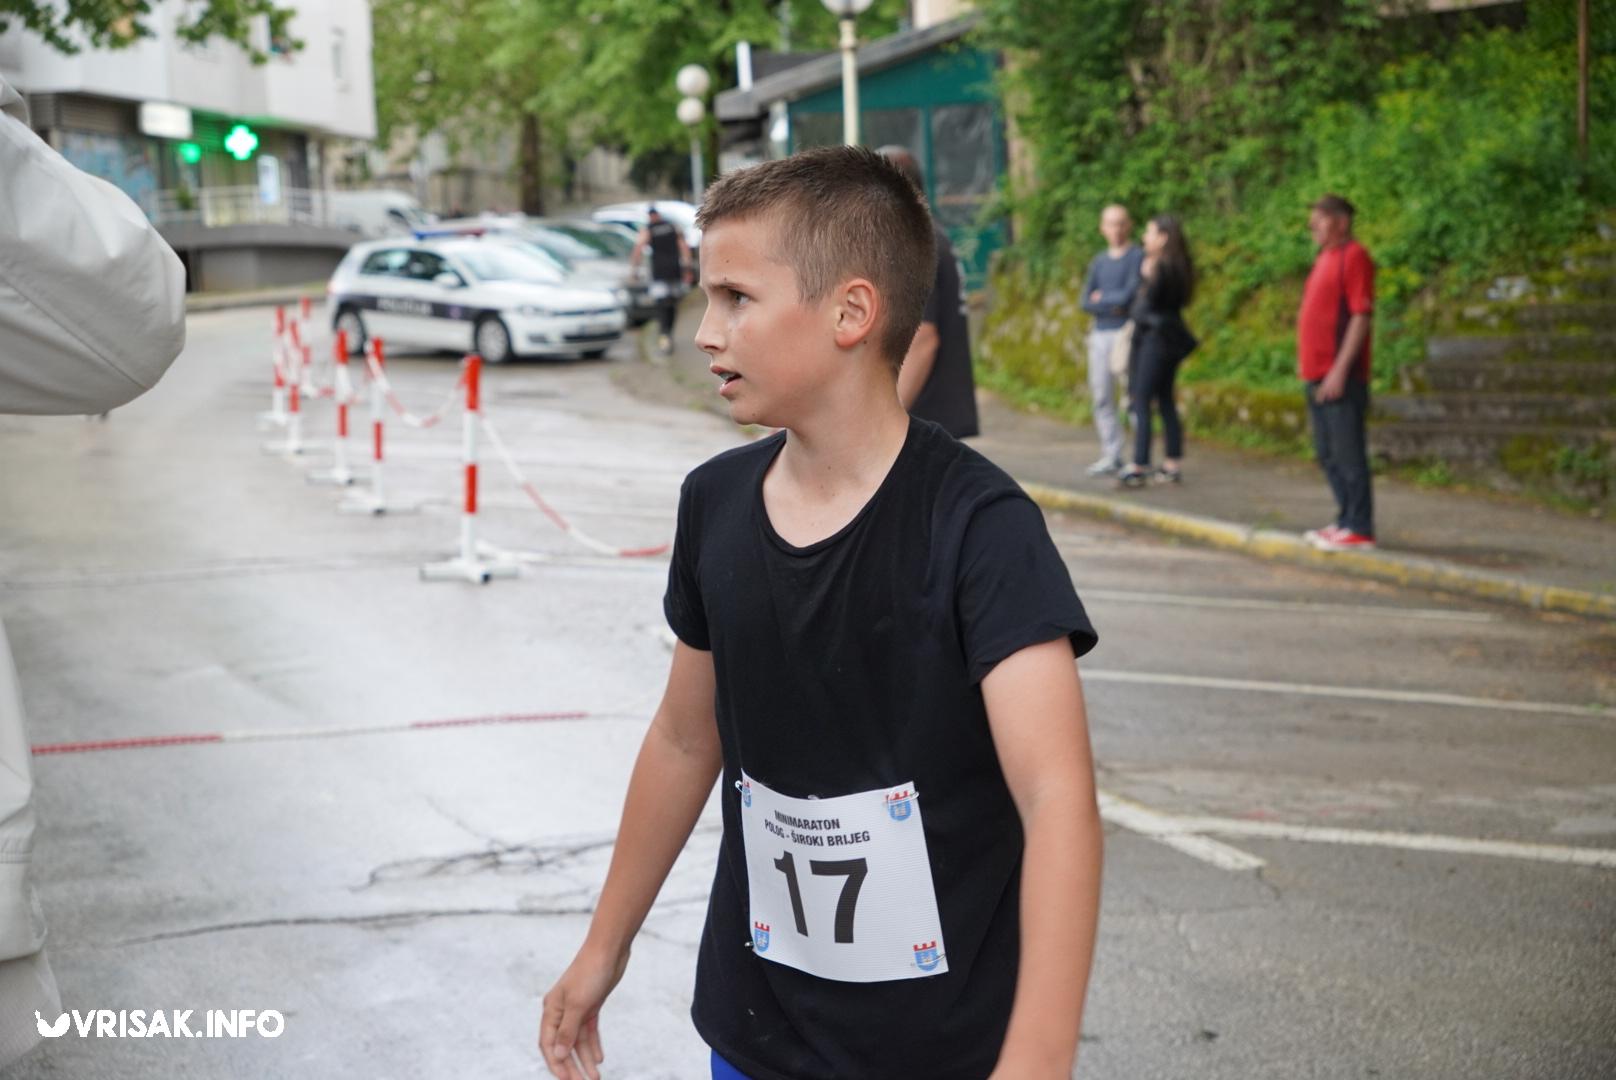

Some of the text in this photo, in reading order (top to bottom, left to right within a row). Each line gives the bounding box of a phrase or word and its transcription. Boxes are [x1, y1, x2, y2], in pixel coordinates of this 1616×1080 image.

[764, 819, 785, 839] POLOG
[791, 830, 824, 847] ŠIROKI
[826, 830, 871, 847] BRIJEG
[774, 810, 840, 830] MINIMARATON
[774, 850, 868, 944] 17
